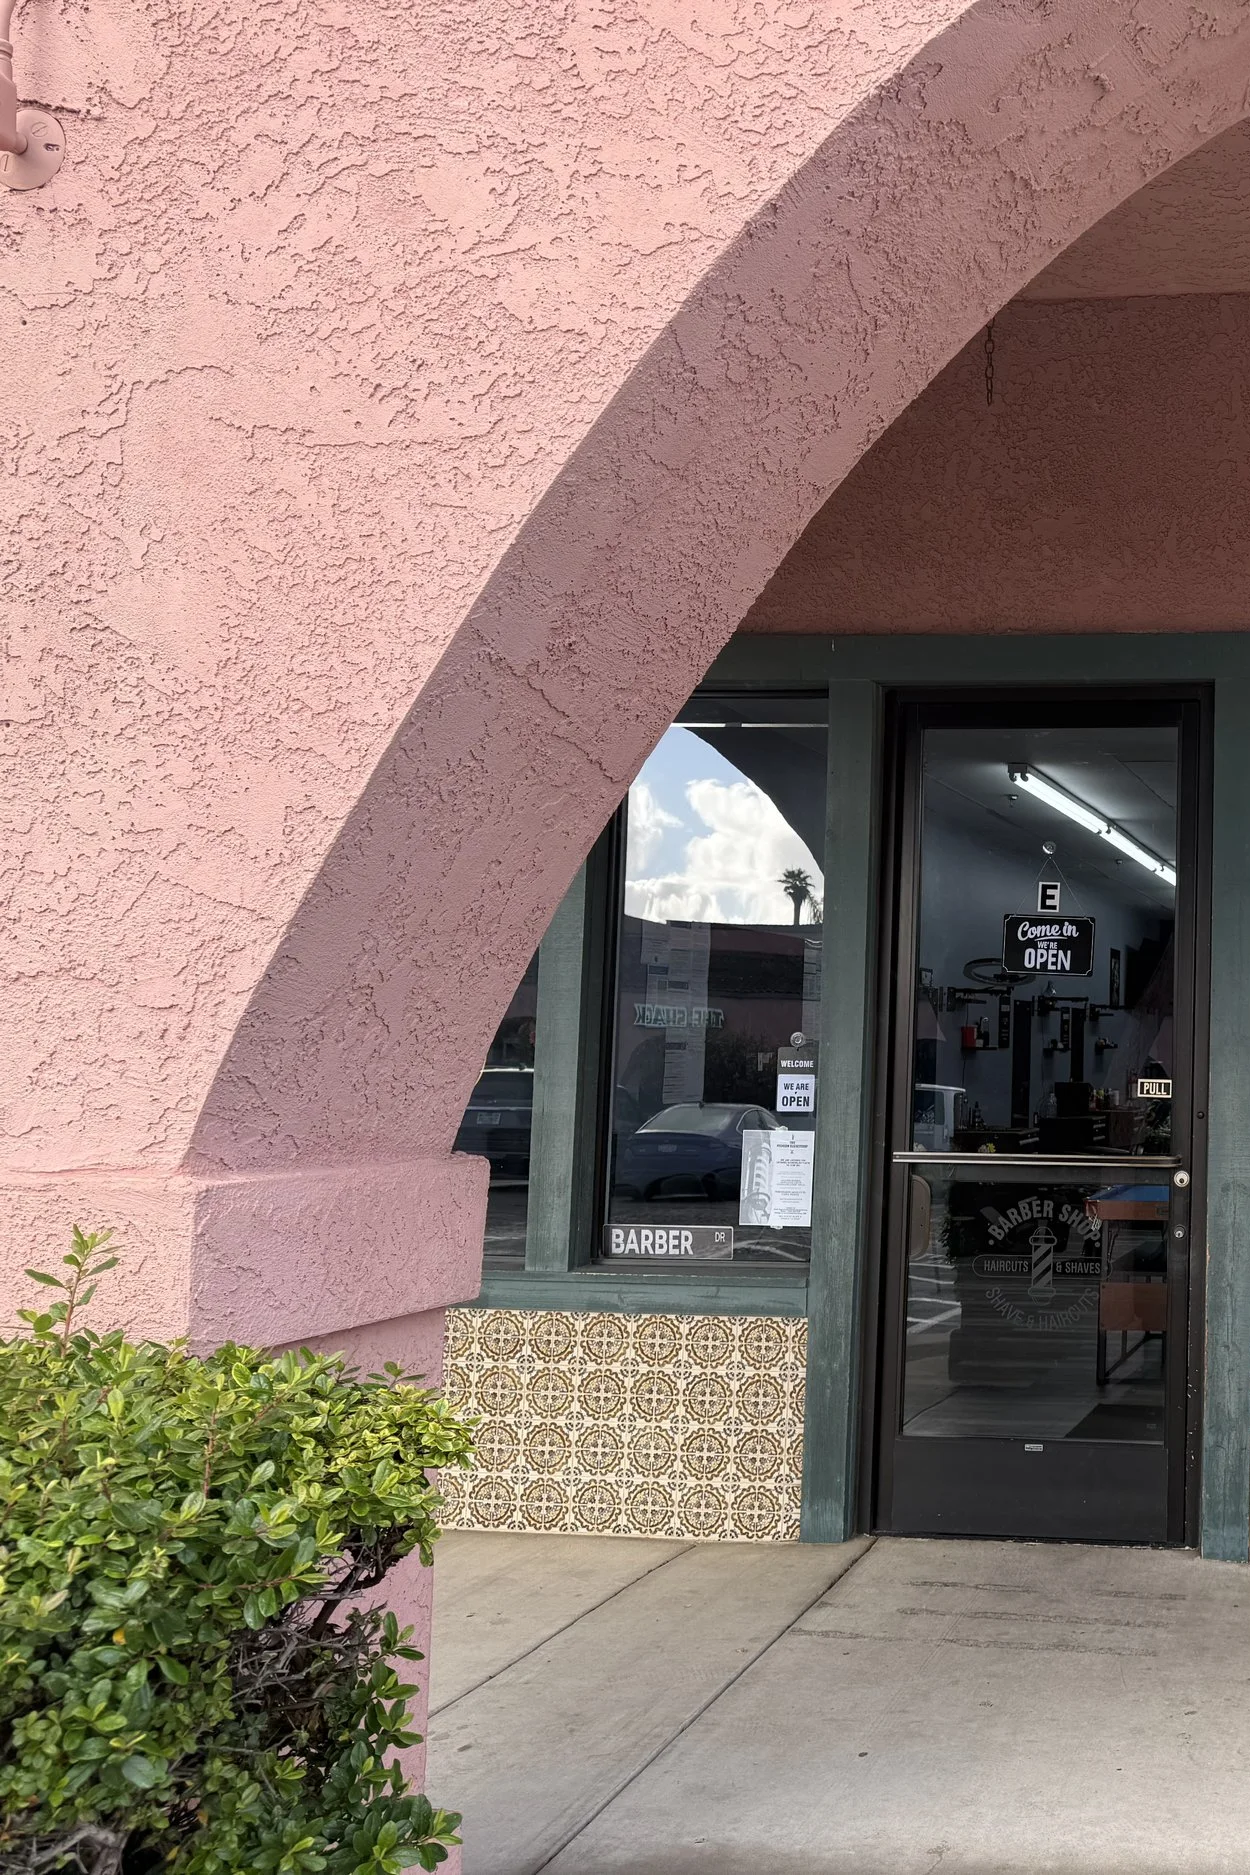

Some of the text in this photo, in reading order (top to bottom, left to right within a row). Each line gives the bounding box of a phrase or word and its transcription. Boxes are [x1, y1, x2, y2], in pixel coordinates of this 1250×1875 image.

[1040, 883, 1059, 911] E
[1017, 921, 1079, 942] Come in
[1037, 941, 1058, 950] WE'RE
[1023, 947, 1072, 971] OPEN
[780, 1060, 814, 1068] WELCOME
[783, 1083, 810, 1091] WE ARE
[1143, 1082, 1167, 1095] PULL
[781, 1095, 810, 1107] OPEN
[988, 1200, 1101, 1241] BARBER SHOP
[611, 1228, 726, 1255] BARBER DR
[983, 1260, 1101, 1274] HAIRCUTS & SHAVES
[985, 1286, 1025, 1326] SHAVE
[1039, 1288, 1099, 1330] HAIRCUTS
